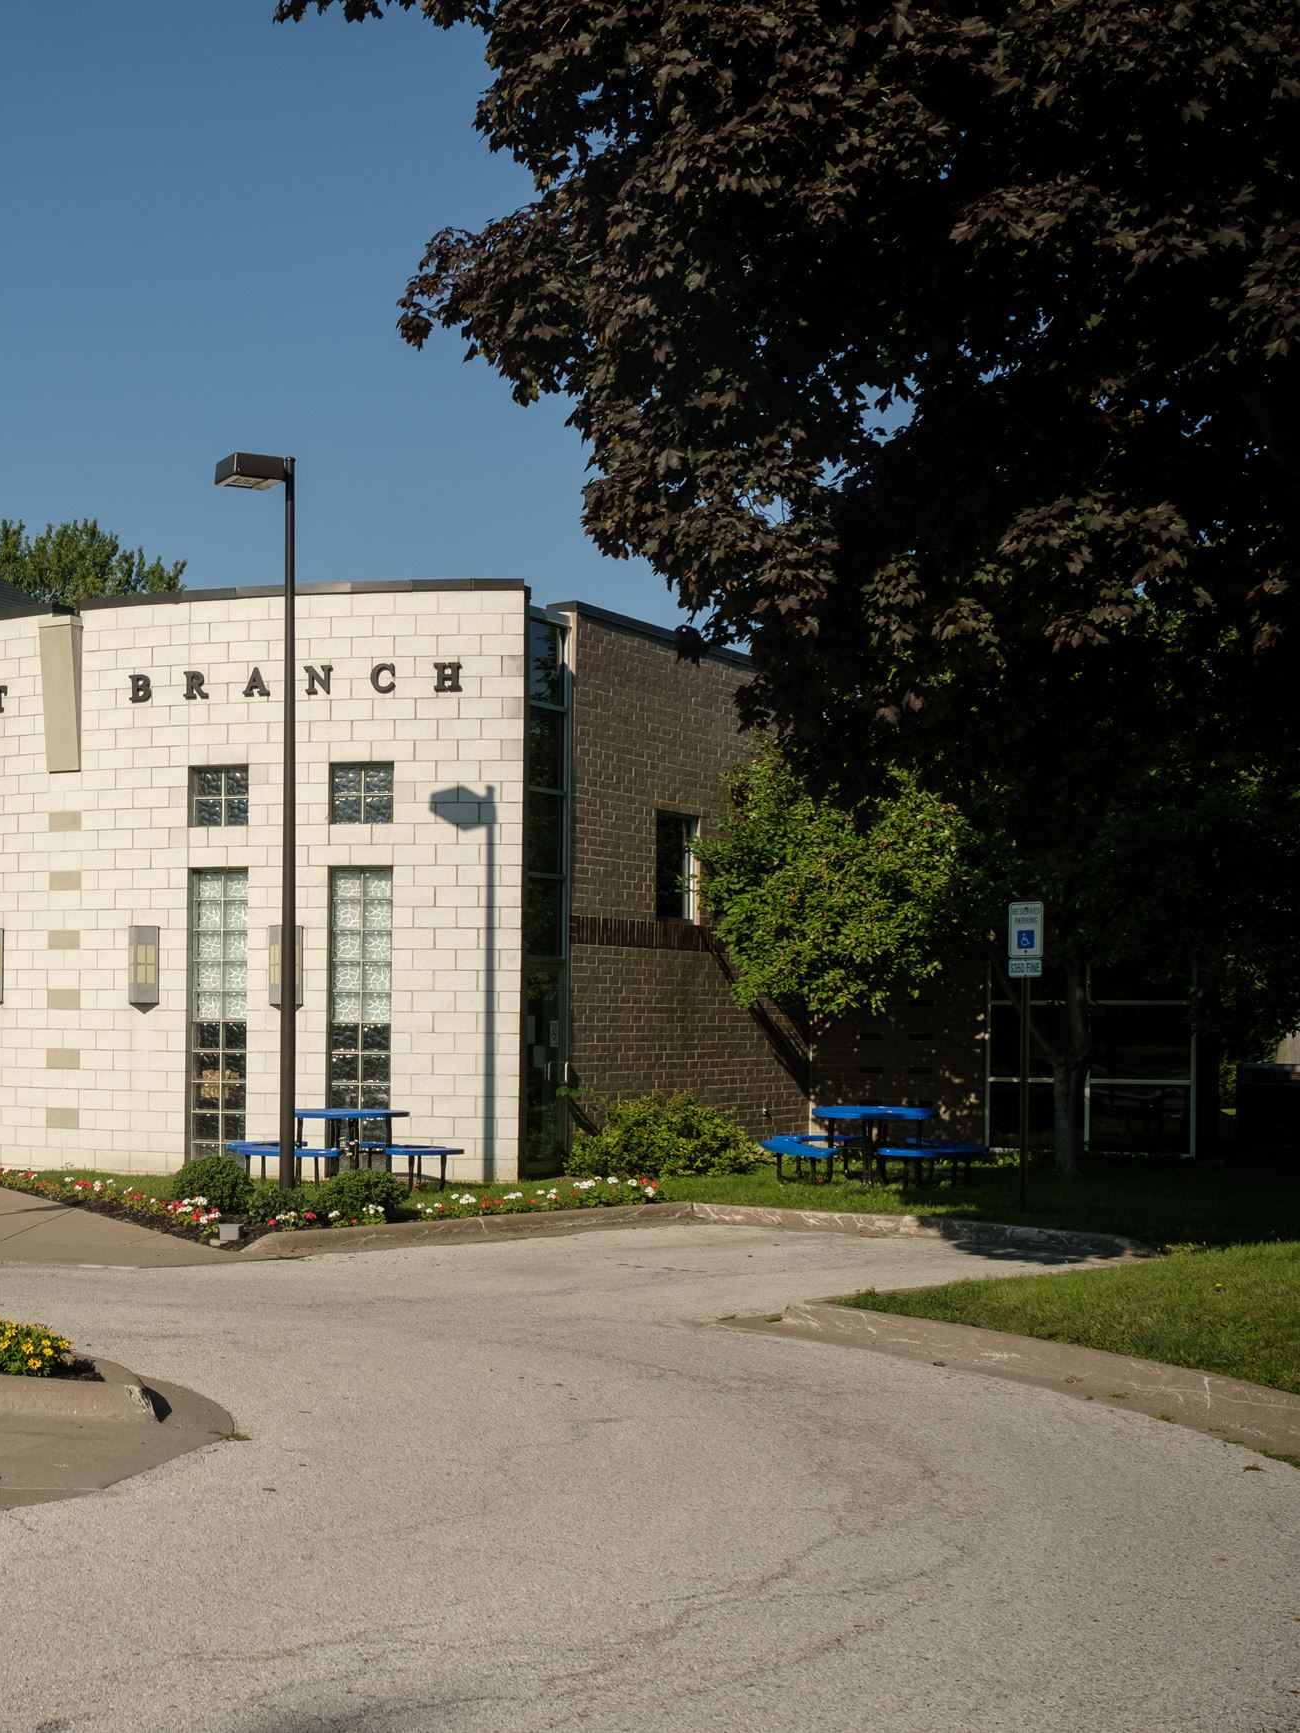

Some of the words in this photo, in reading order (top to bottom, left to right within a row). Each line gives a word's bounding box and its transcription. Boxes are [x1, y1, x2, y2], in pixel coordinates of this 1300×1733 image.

[129, 662, 462, 703] BRANCH
[1010, 962, 1025, 974] $350
[1026, 962, 1041, 974] FINE
